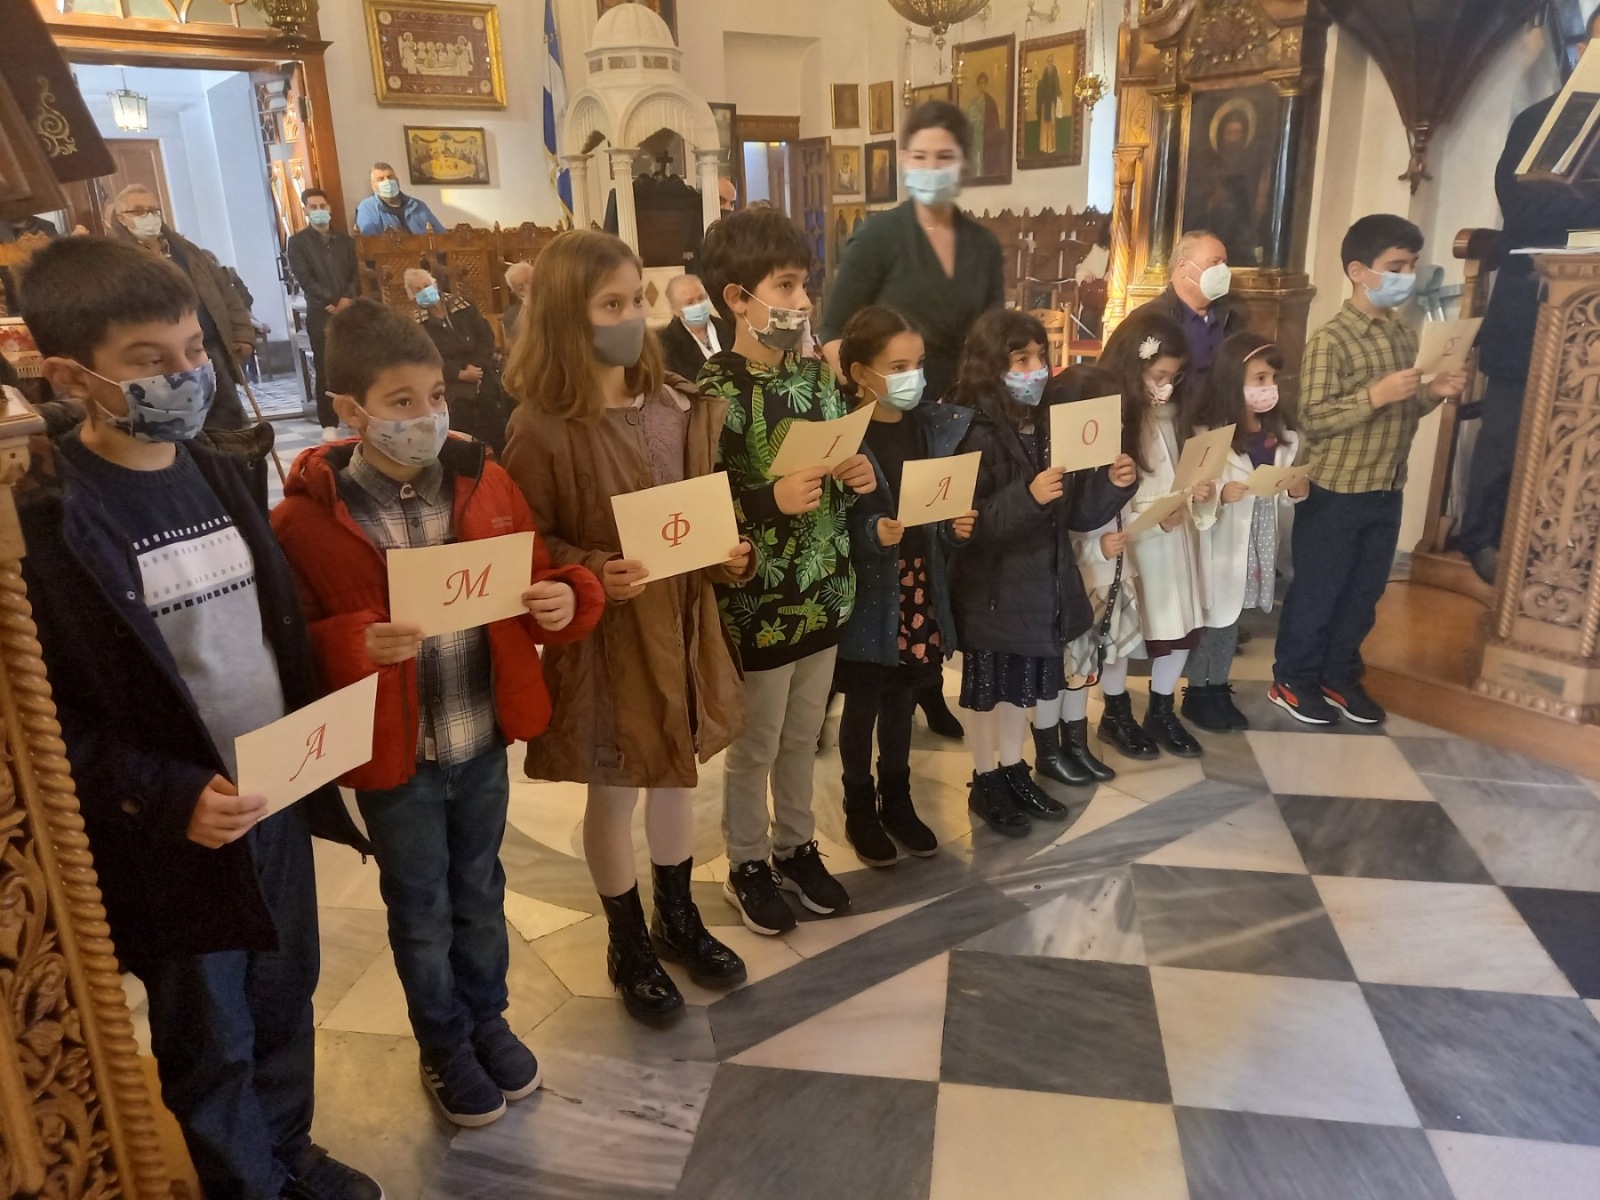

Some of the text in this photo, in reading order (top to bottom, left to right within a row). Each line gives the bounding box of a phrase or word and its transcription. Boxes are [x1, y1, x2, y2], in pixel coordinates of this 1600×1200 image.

[925, 475, 952, 508] Λ
[661, 511, 691, 549] Φ
[442, 562, 493, 607] Μ
[288, 722, 327, 783] Α
